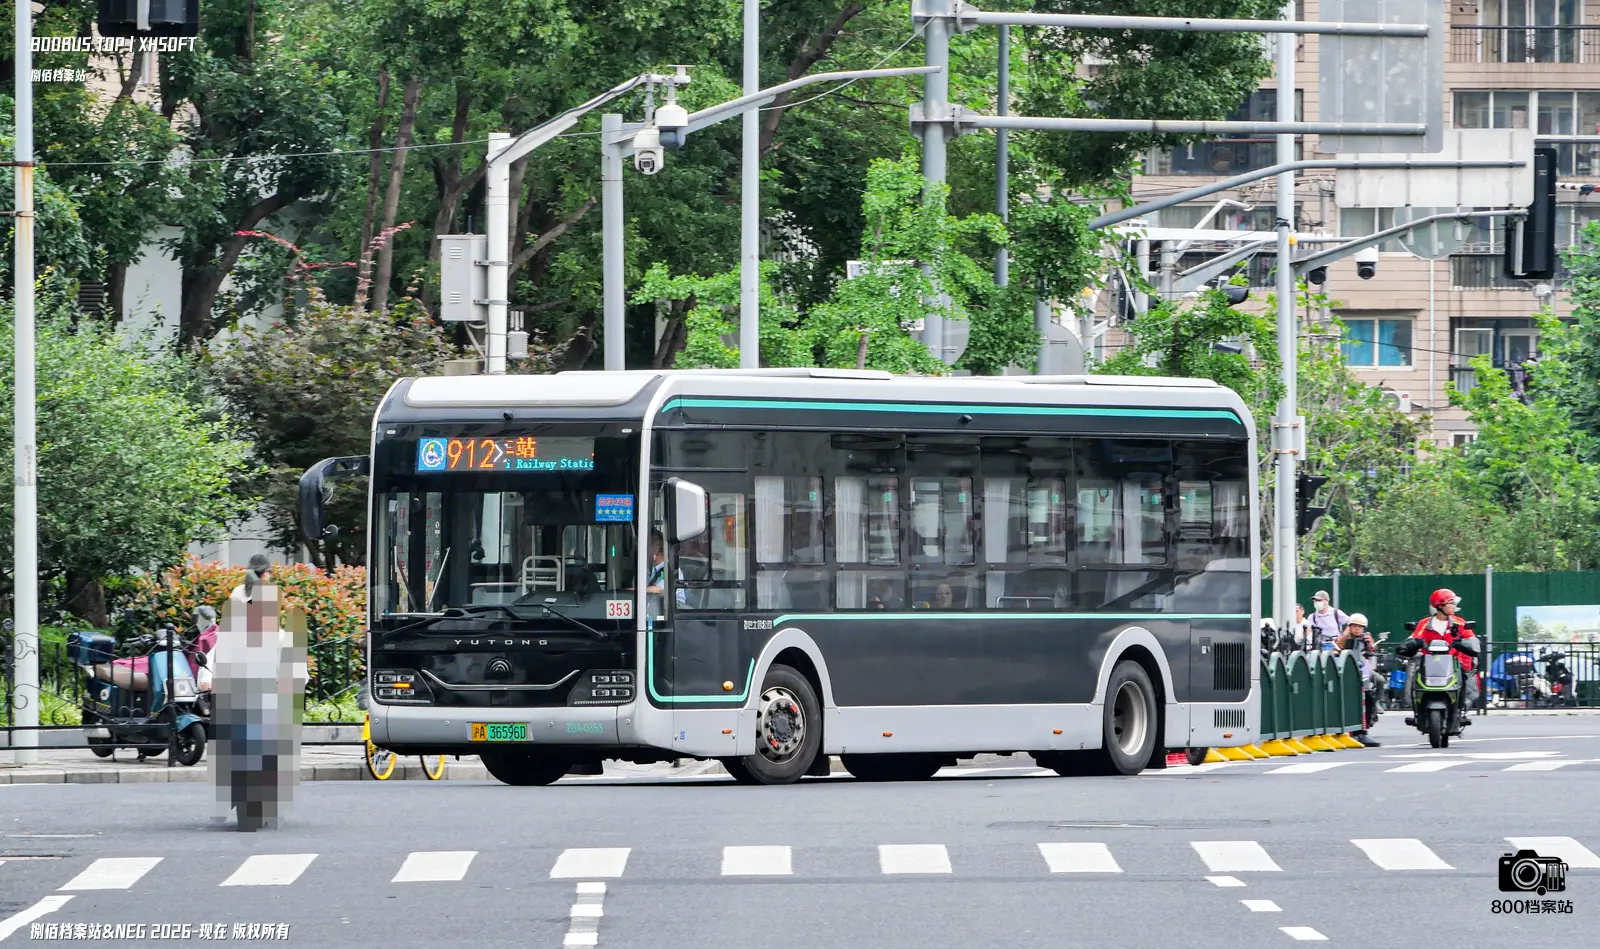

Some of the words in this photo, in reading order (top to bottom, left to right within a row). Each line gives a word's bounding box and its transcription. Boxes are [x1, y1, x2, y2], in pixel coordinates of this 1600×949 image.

[447, 439, 496, 468] 912
[516, 459, 557, 470] Railway
[608, 602, 630, 616] 353
[489, 725, 527, 739] 36596D
